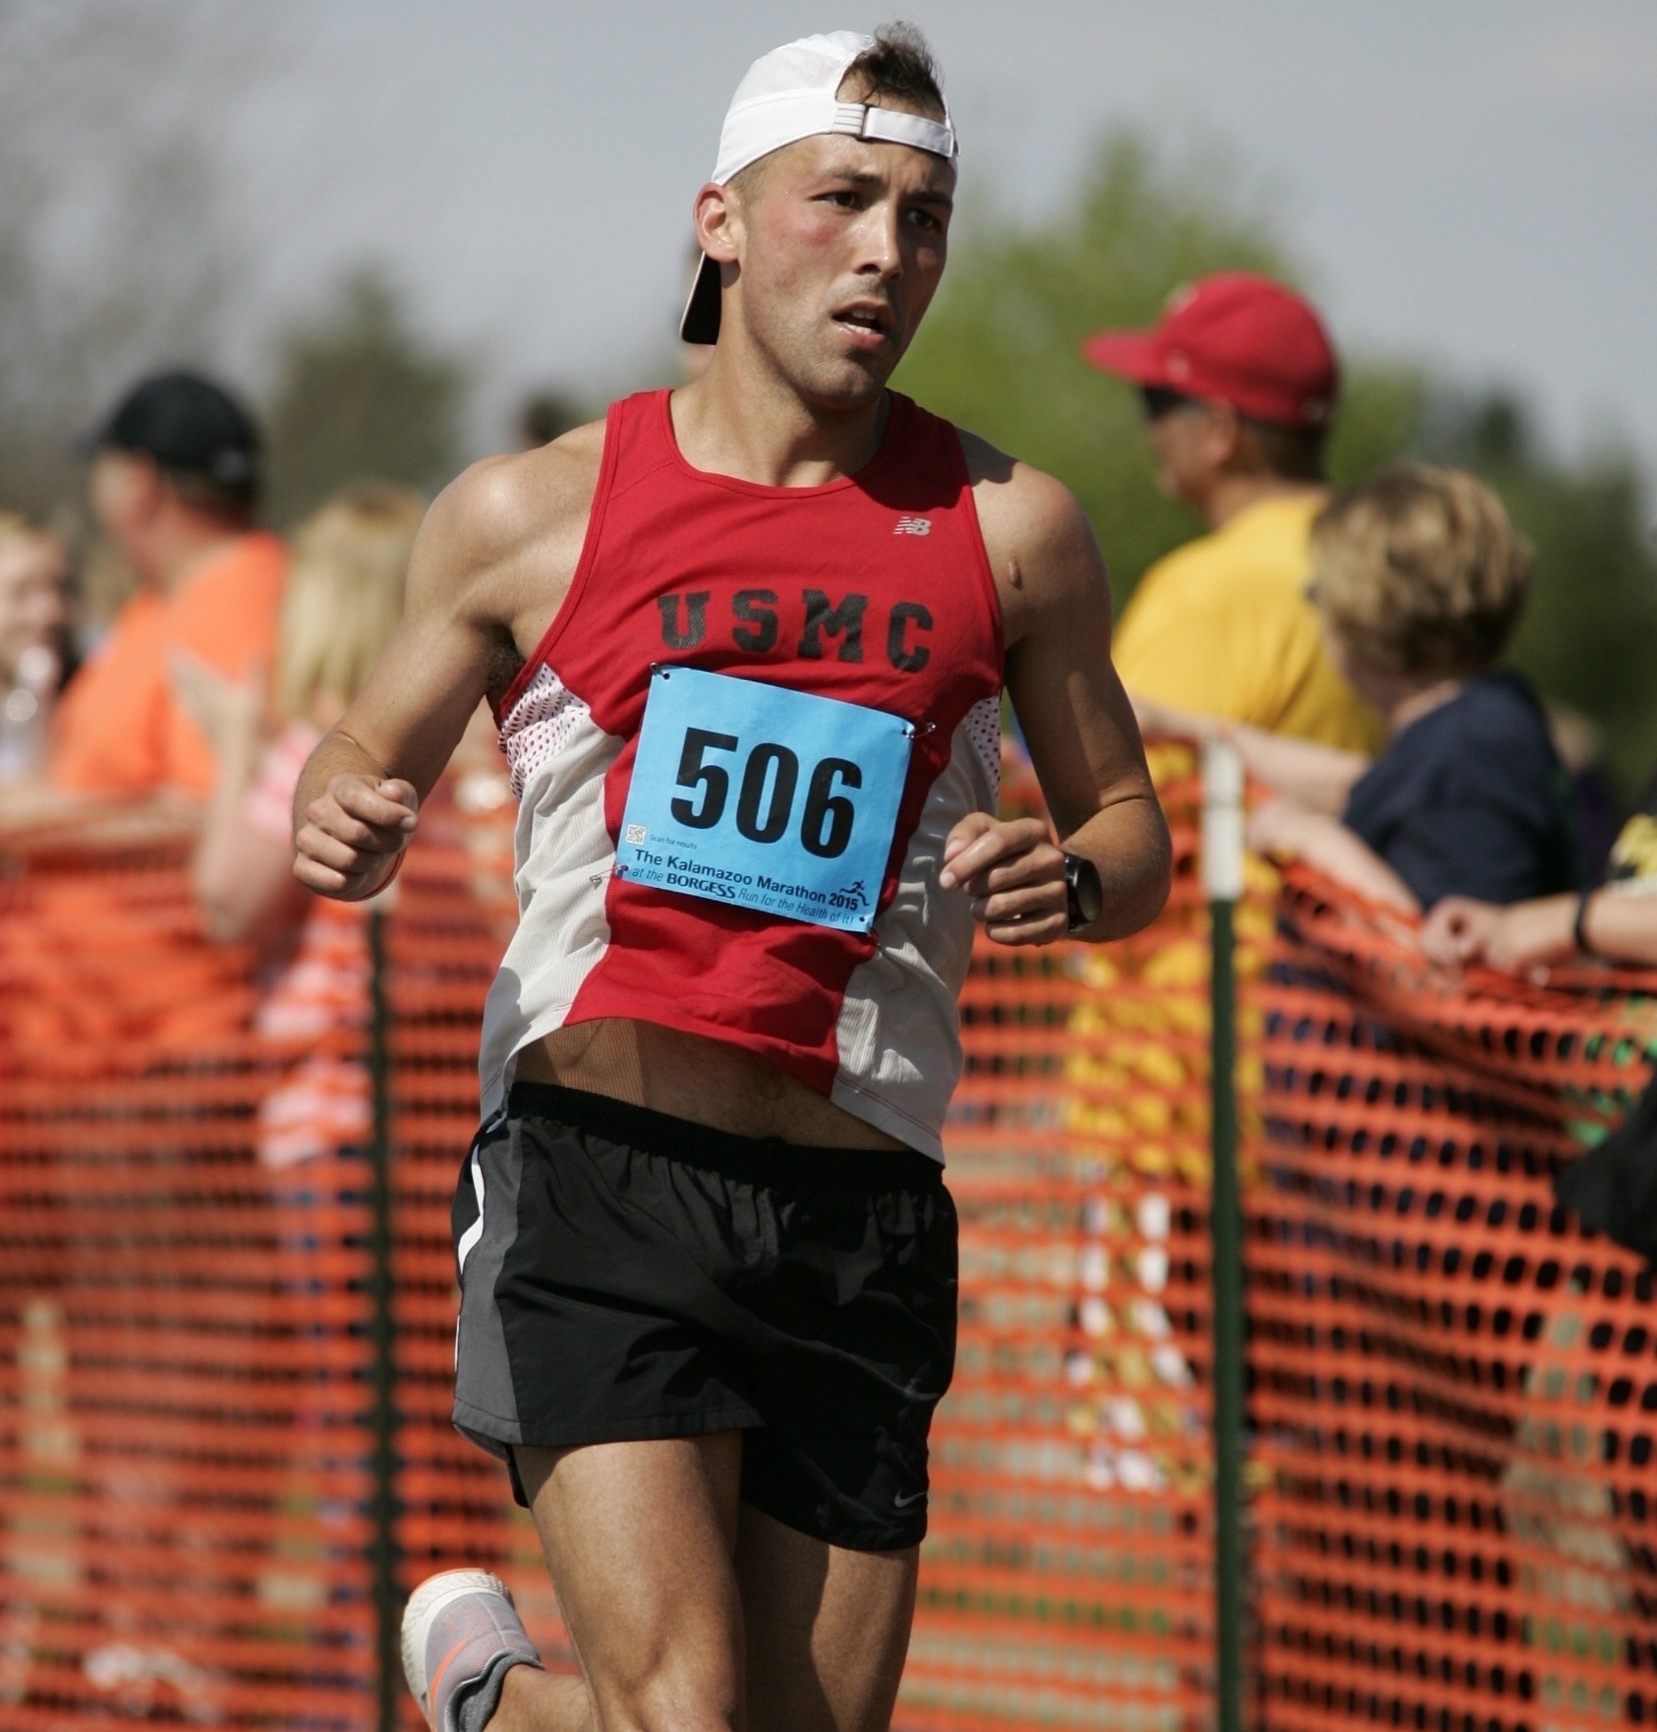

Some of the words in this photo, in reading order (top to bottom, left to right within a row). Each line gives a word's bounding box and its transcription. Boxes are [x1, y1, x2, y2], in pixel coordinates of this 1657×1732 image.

[656, 588, 934, 674] USMC
[670, 726, 863, 859] 506
[632, 867, 643, 877] at
[646, 868, 664, 882] the
[666, 872, 736, 899] BORGESS
[738, 887, 758, 903] Run
[760, 892, 778, 907] for
[777, 896, 794, 911] the
[796, 902, 828, 921] Health
[830, 911, 841, 923] of
[635, 848, 663, 866] The
[667, 855, 753, 886] Kalamazoo
[757, 875, 827, 904] Marathon
[828, 892, 859, 911] 2015
